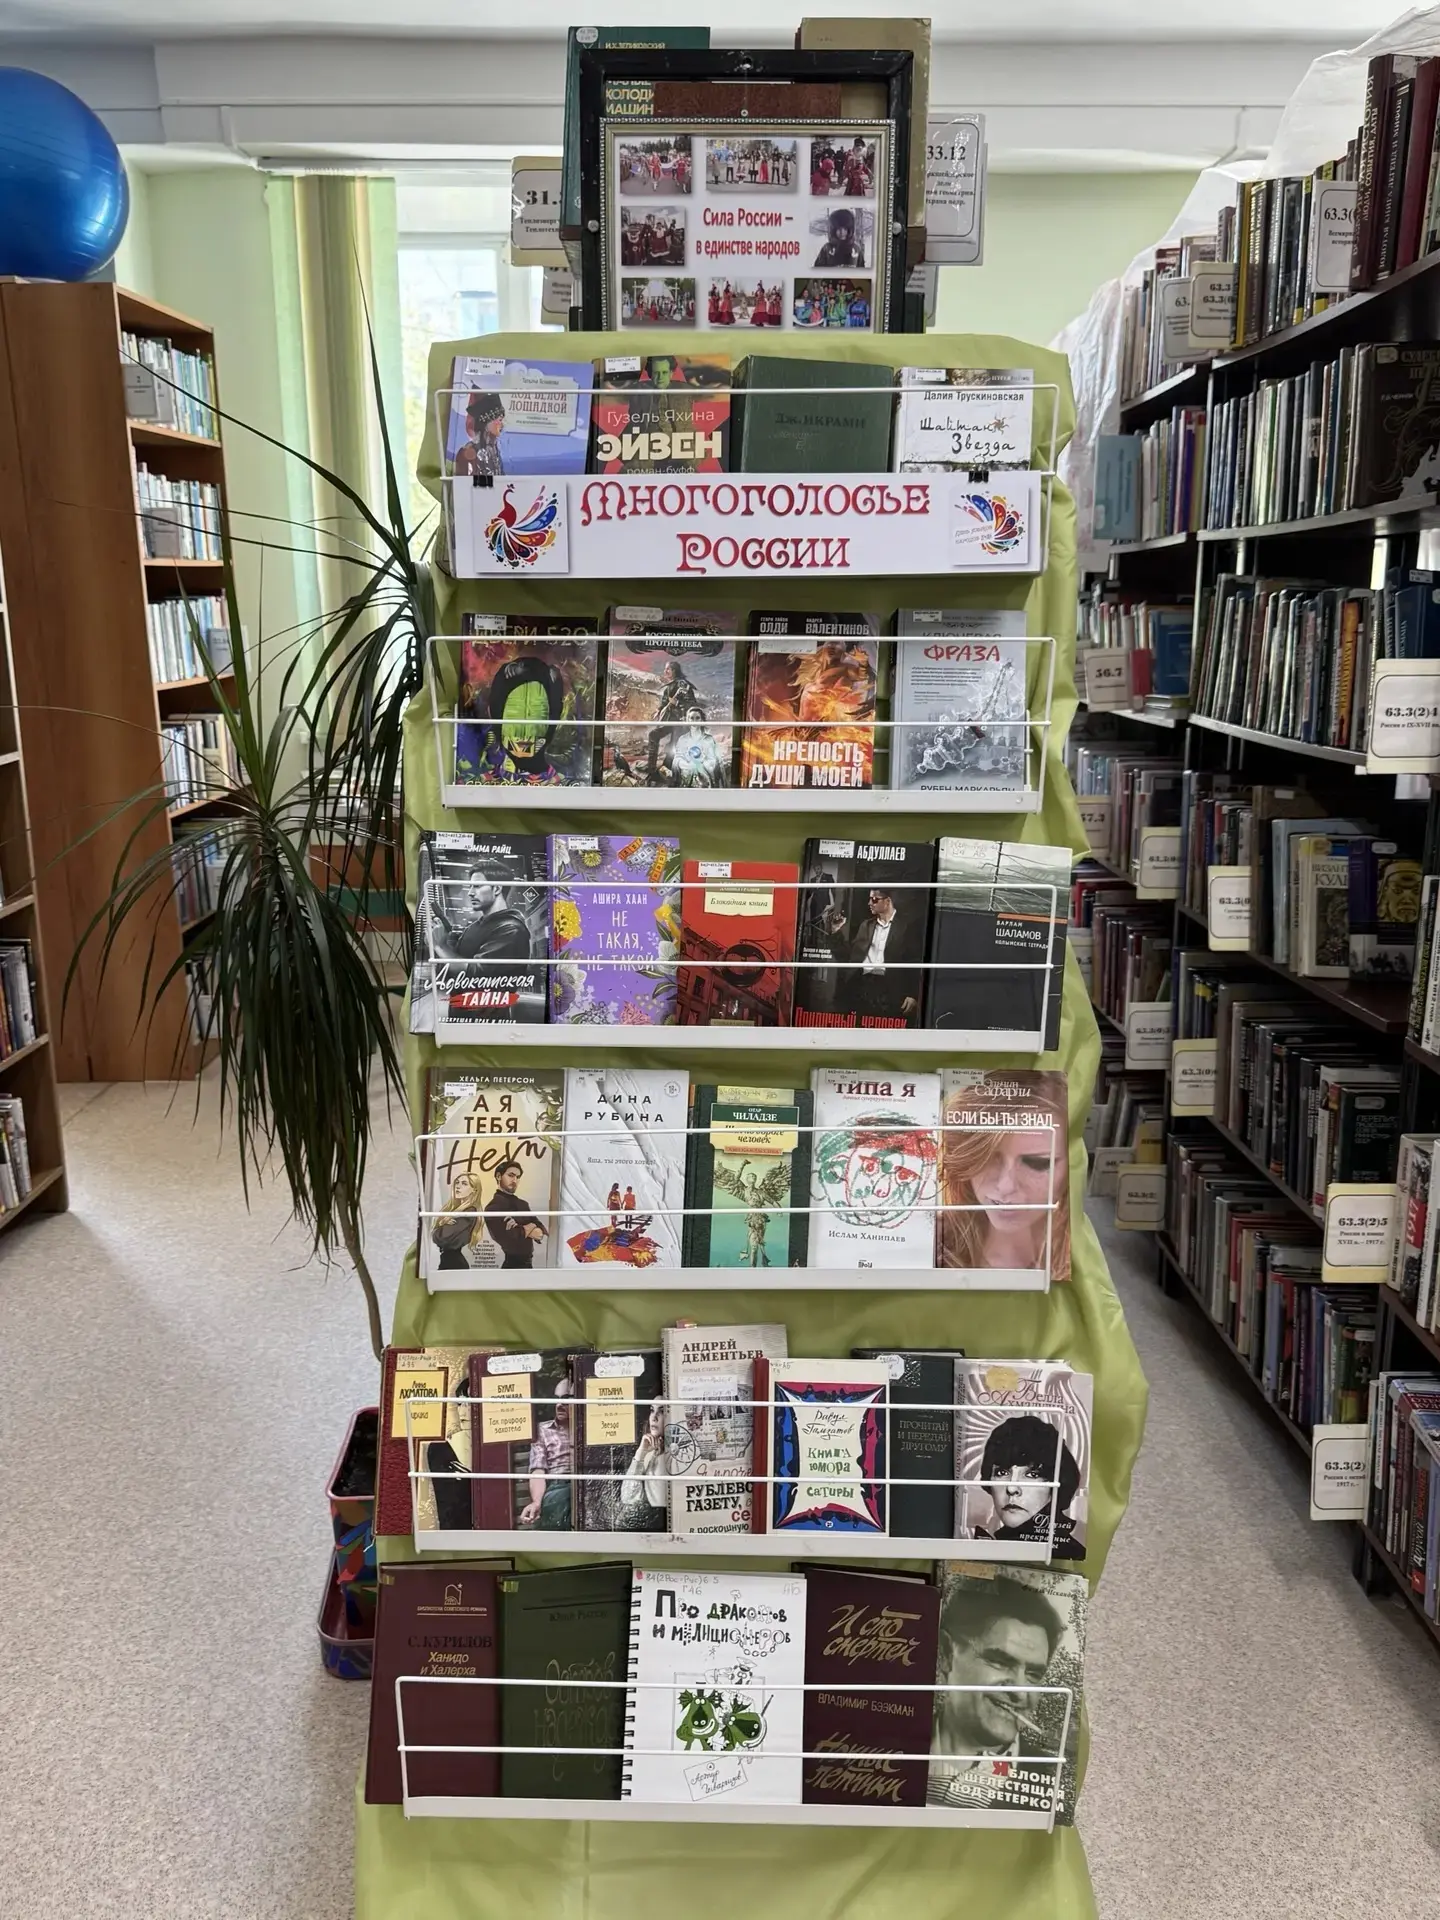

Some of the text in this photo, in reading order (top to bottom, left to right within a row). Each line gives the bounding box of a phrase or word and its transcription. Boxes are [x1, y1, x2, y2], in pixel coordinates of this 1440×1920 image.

[702, 207, 735, 227] Сила
[737, 207, 783, 227] России
[695, 240, 801, 260] в единстве народов
[923, 391, 1025, 402] Далия Трускиновская
[606, 409, 715, 427] Гузель Яхина
[596, 426, 722, 462] ЭЙЗЕН
[676, 533, 852, 575] РОССИИ
[759, 622, 870, 636] ОЛДИ ВАЛЕНТИНОВ
[923, 644, 1000, 662] ФРАЗА
[773, 740, 865, 763] КРЕПОСТЬ
[748, 760, 863, 788] ДУШИ МОЕЙ
[491, 844, 512, 854] РАЙЦ
[857, 844, 906, 861] АБДУЛЛАЕВ
[592, 893, 648, 905] АШИРА ХААН
[611, 910, 629, 928] НЕ
[996, 920, 1023, 928] ВАРЛАМ
[597, 931, 644, 952] ТАКАЯ,
[995, 928, 1042, 941] ШАЛАМОВ
[586, 951, 655, 972] НЕ ТАКОЙ
[424, 963, 535, 995] Адвокатская
[462, 988, 511, 1006] ТАЙНА
[459, 1075, 535, 1084] ХЕЛЬГА ПЕТЕРСОН
[472, 1094, 513, 1113] А Я
[597, 1093, 653, 1104] ДИНА
[464, 1116, 519, 1133] ТЕБЯ
[584, 1111, 664, 1123] РУБИНА
[732, 1111, 778, 1122] ЧИЛАДЗЕ
[946, 1110, 1019, 1126] ЕСЛИ БЫ ТЫ
[737, 1134, 772, 1144] человек
[681, 1338, 737, 1353] АНДРЕЙ
[681, 1349, 765, 1365] ДЕМЕНТЬЕВ
[411, 1380, 427, 1390] Анна
[598, 1387, 623, 1397] ТАТЬЯНА
[399, 1387, 439, 1400] АХМАТОВА
[489, 1416, 527, 1427] Так природа
[686, 1497, 743, 1513] ГАЗЕТУ,
[422, 1635, 493, 1649] КУРИЛОВ
[427, 1651, 470, 1664] Ханидо
[419, 1664, 477, 1677] и Халерха
[818, 1692, 915, 1718] ВЛАДИМИР БЭЭКМАН
[949, 1781, 985, 1799] ПОД
